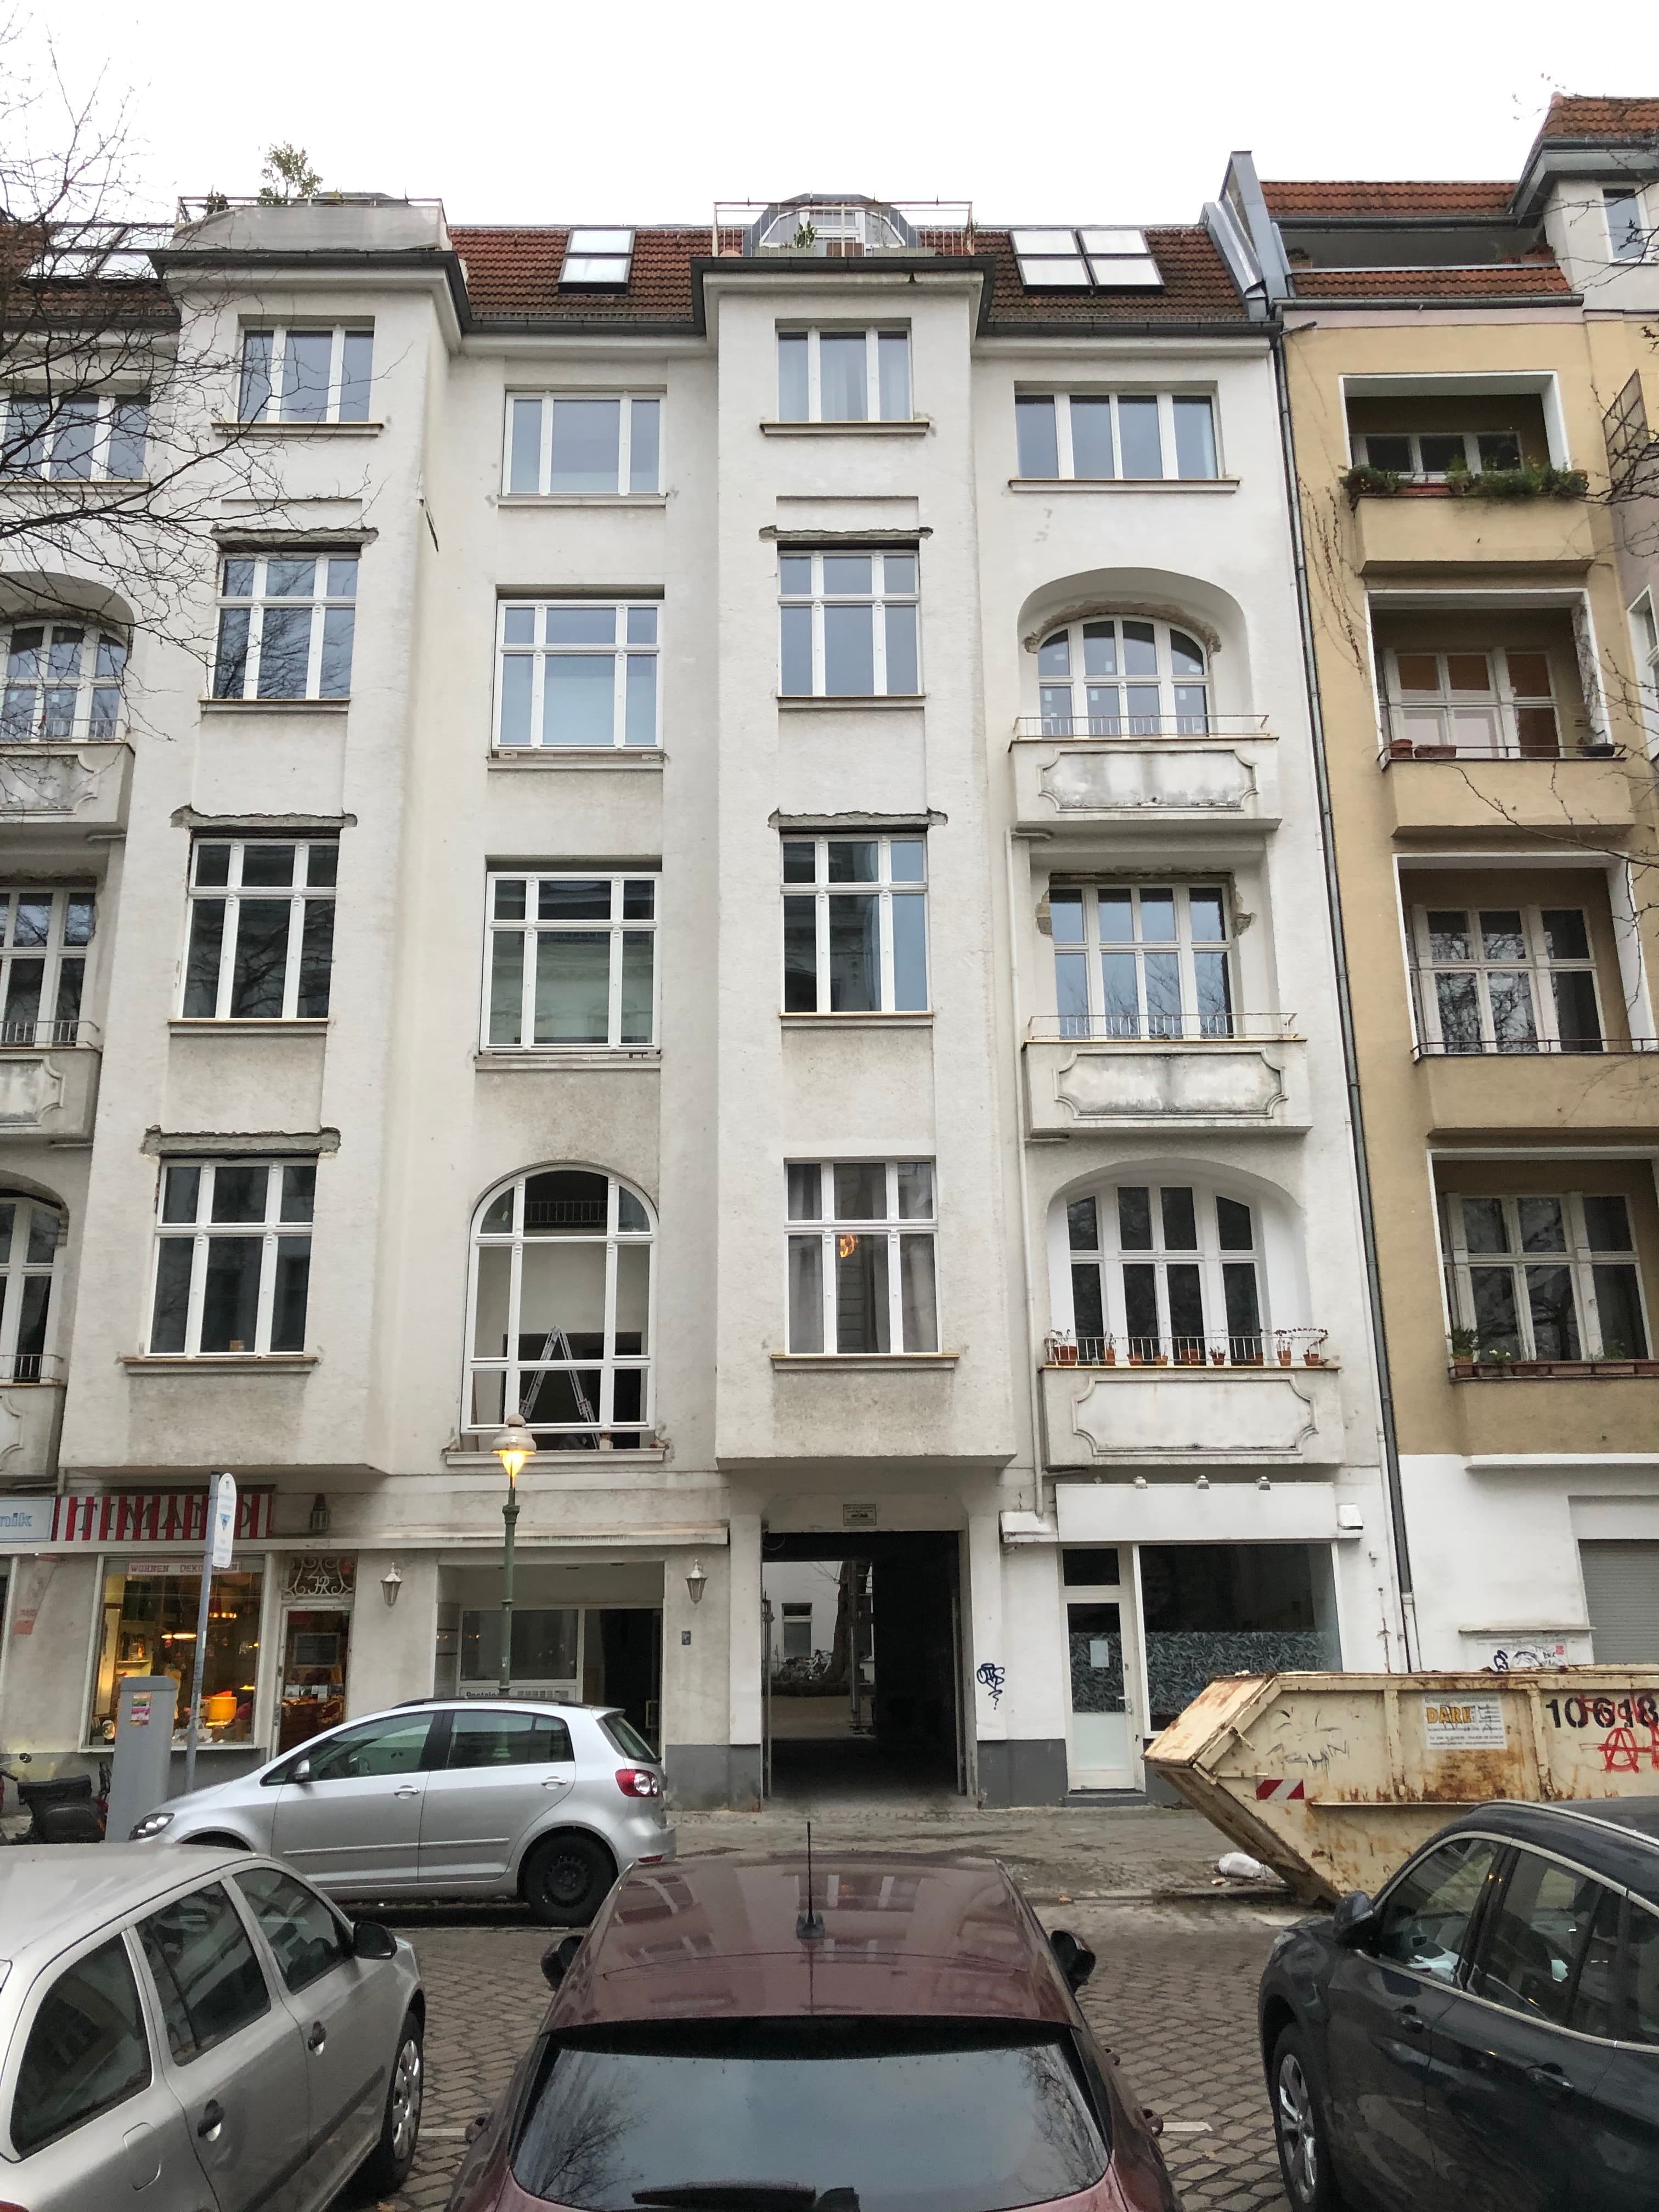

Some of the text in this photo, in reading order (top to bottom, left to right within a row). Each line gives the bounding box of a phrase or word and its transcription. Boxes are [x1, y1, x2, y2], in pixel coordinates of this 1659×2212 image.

[131, 1564, 170, 1573] WOHNEN
[1426, 1706, 1471, 1724] DARE
[1545, 1697, 1658, 1728] 10618
